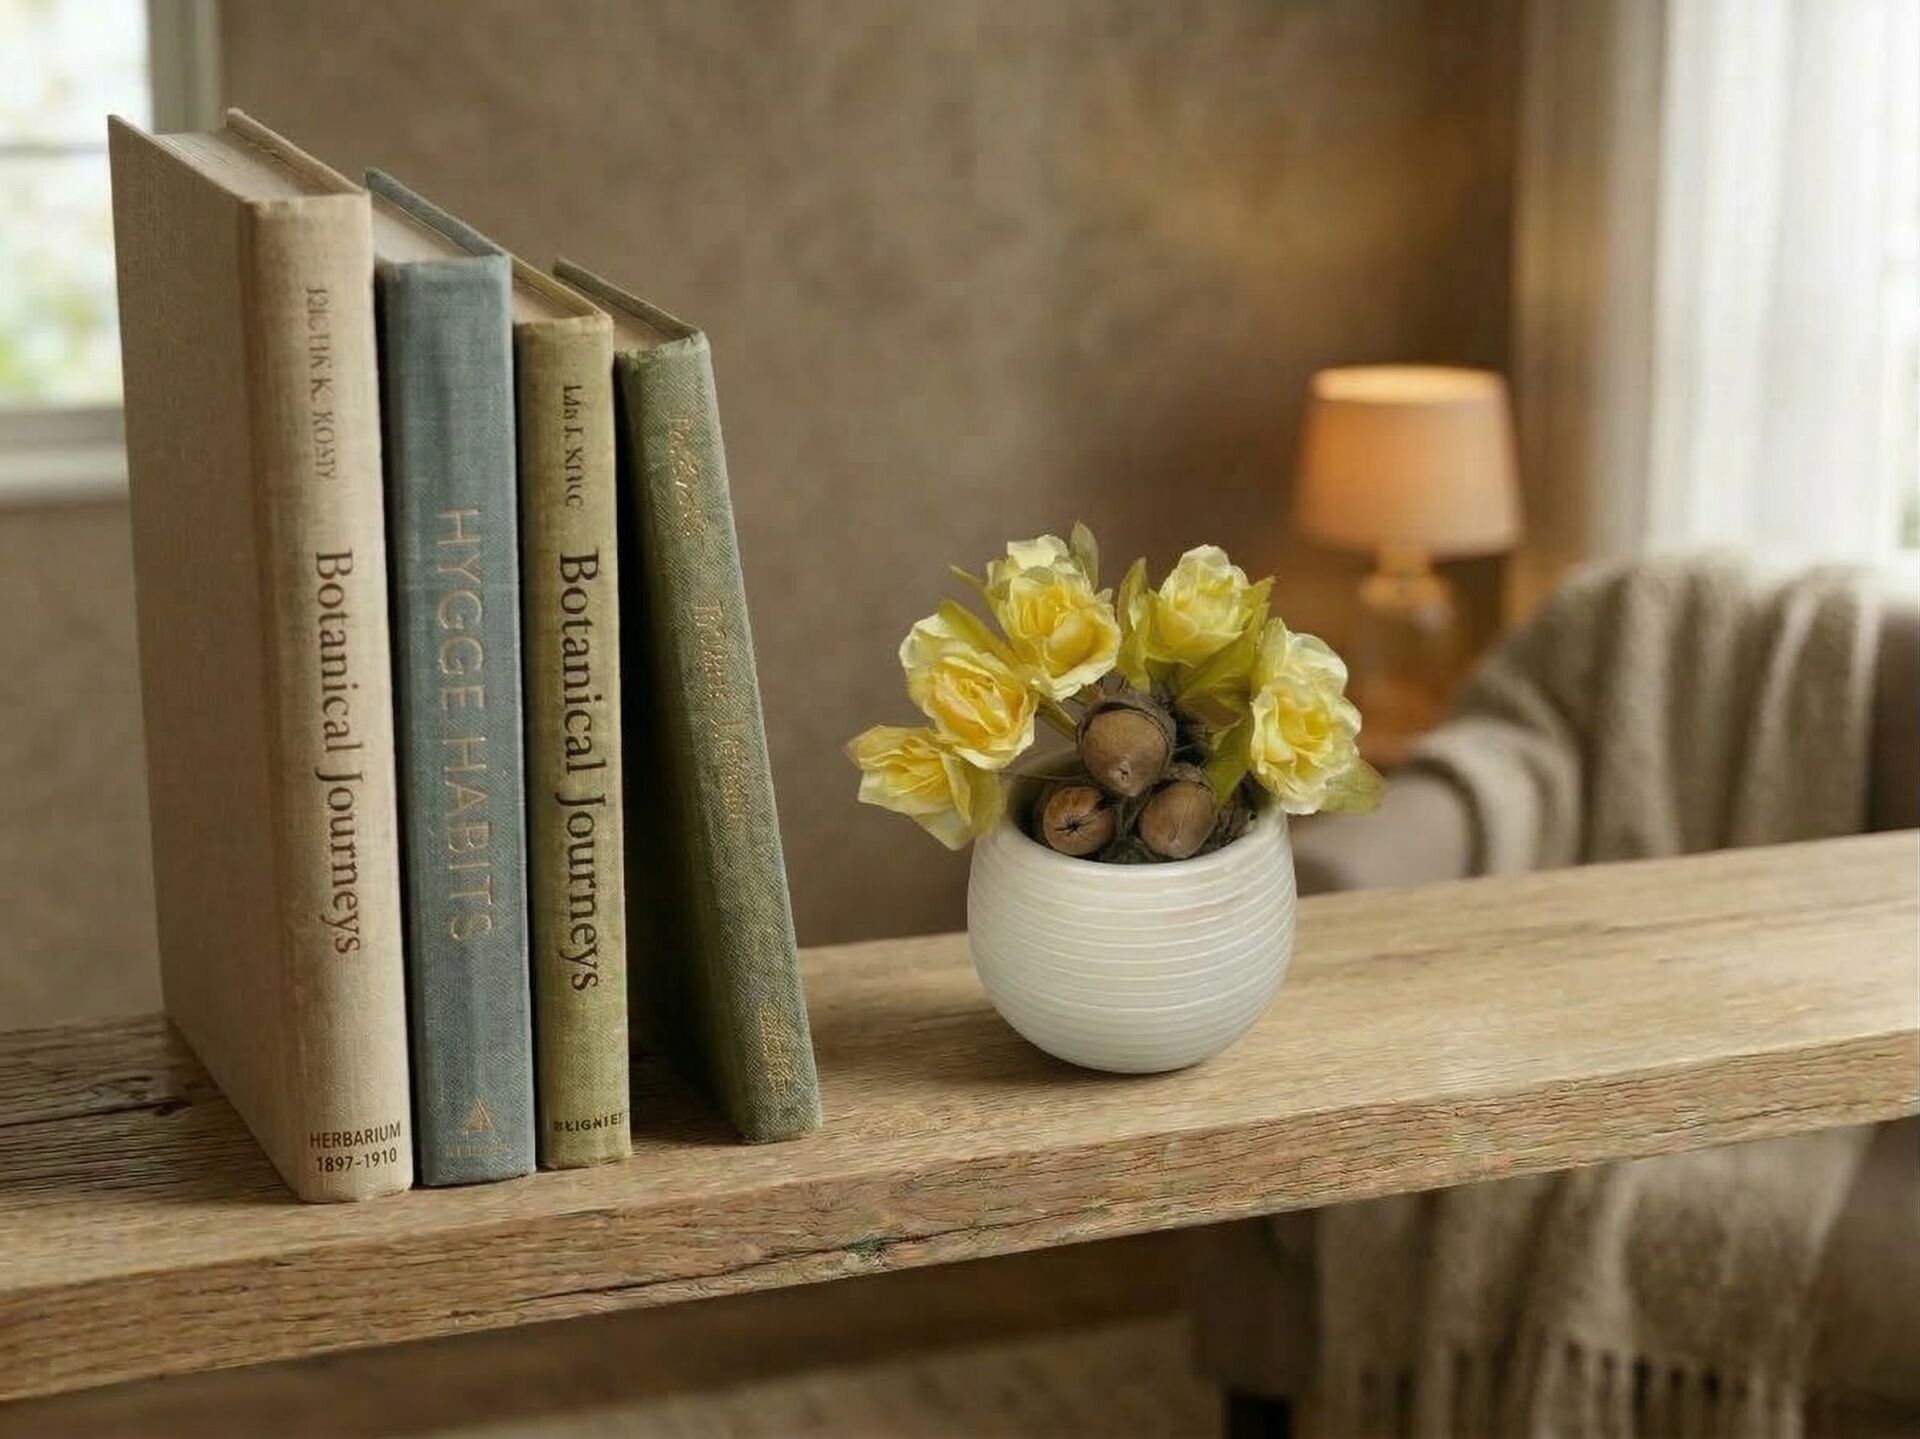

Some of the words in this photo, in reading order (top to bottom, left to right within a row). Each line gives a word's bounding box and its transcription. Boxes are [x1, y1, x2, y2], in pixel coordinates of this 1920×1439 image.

[315, 547, 365, 754] Botanical
[437, 508, 486, 711] HYGGE
[559, 547, 608, 776] Botanical
[314, 765, 364, 955] Journeys
[442, 735, 494, 941] HABITS
[554, 792, 607, 992] Journeys
[309, 1120, 401, 1149] HERBARIUM
[316, 1146, 398, 1173] 1897-1910
